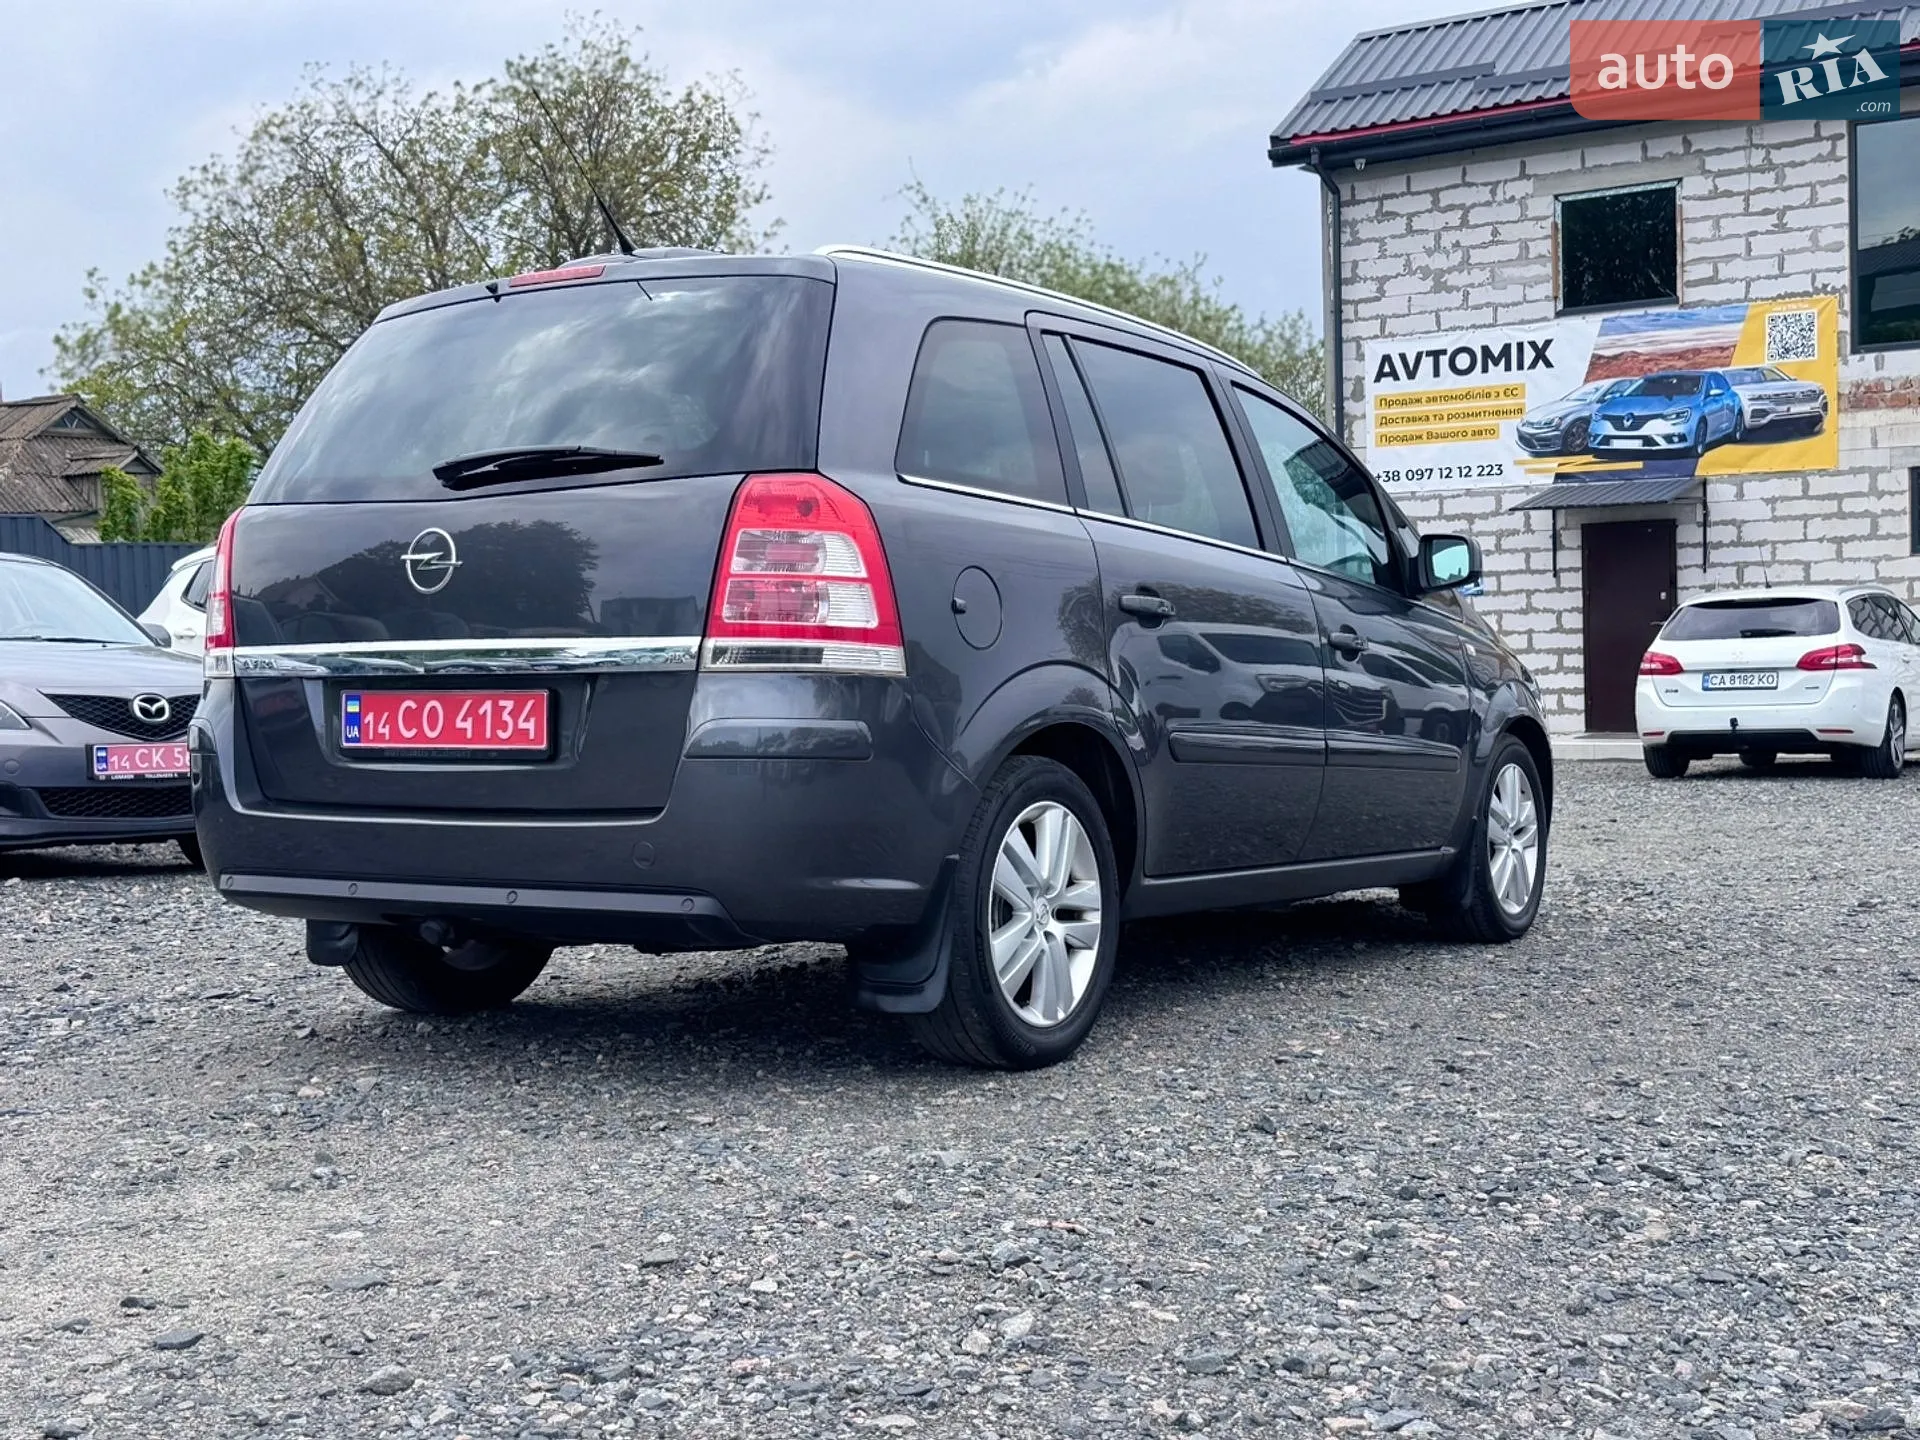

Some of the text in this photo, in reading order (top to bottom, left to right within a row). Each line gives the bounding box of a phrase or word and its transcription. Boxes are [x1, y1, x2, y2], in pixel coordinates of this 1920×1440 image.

[1373, 338, 1554, 384] AVTOMIX
[1379, 397, 1423, 408] Продаж
[1425, 389, 1492, 404] автомобілів
[1503, 387, 1519, 398] ЄС
[1379, 406, 1523, 426] Доставка та розмитнення
[1379, 427, 1496, 444] Продаж Вашого авто
[1375, 464, 1504, 483] +38 097 12 12 223
[455, 699, 536, 740] 4134
[346, 725, 360, 738] UA
